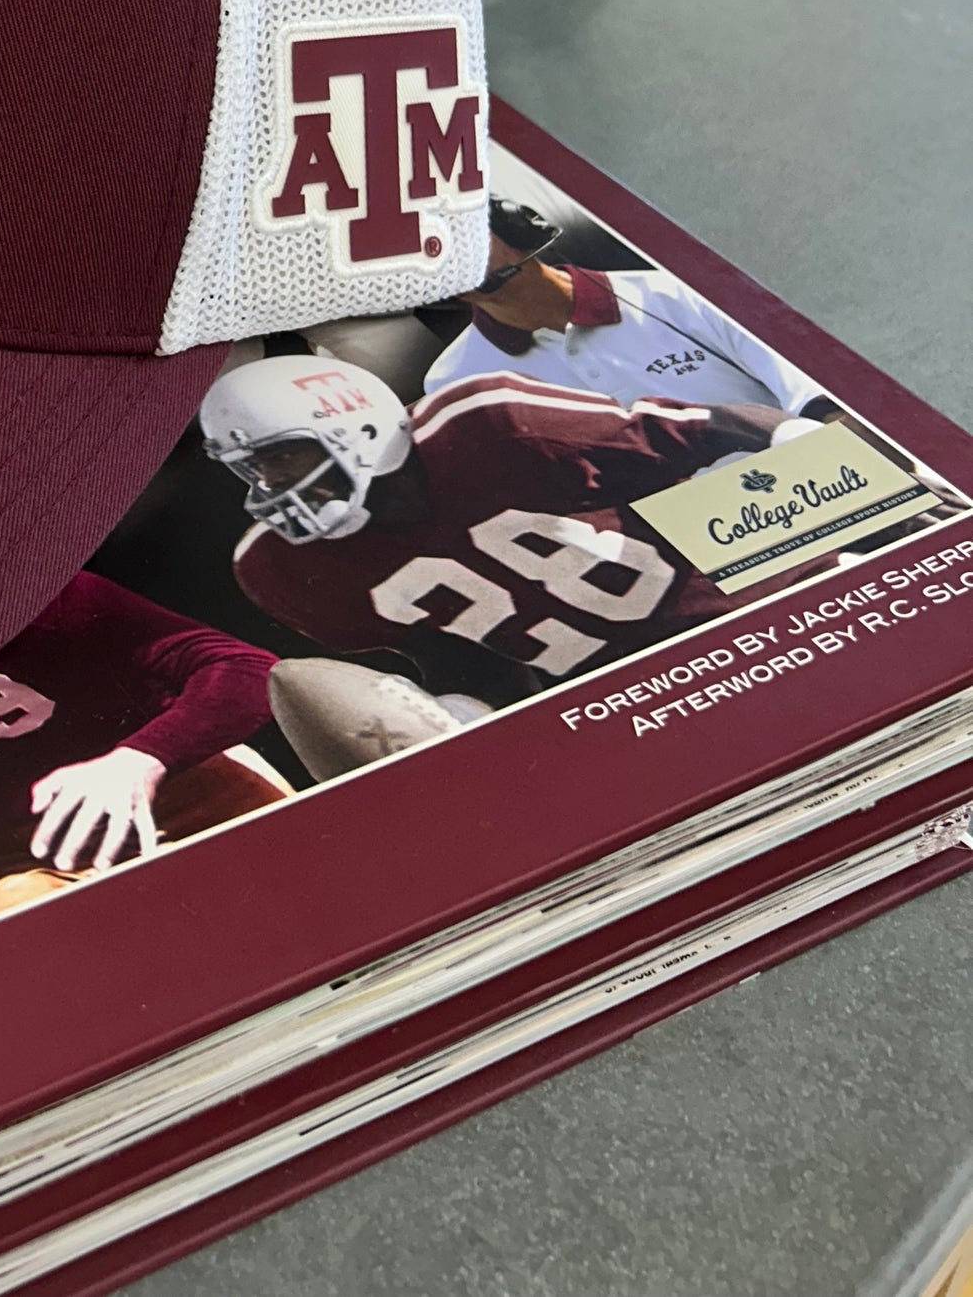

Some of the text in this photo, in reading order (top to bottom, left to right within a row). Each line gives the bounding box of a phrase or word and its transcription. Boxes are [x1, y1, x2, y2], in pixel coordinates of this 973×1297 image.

[646, 350, 705, 374] TEXAS
[708, 502, 805, 545] College
[792, 464, 868, 508] Vault
[725, 551, 772, 574] TREASURE
[773, 540, 803, 559] TROVE
[802, 533, 815, 546] OF
[815, 517, 853, 539] COLLEGE
[853, 504, 882, 524] SPORT
[882, 489, 919, 512] HISTORY
[369, 508, 676, 676] 28
[560, 648, 734, 732] FOREWORD
[732, 625, 778, 658] BY
[787, 581, 887, 637] JACKIE
[631, 645, 815, 737] AFTERWORD
[811, 624, 858, 654] BY
